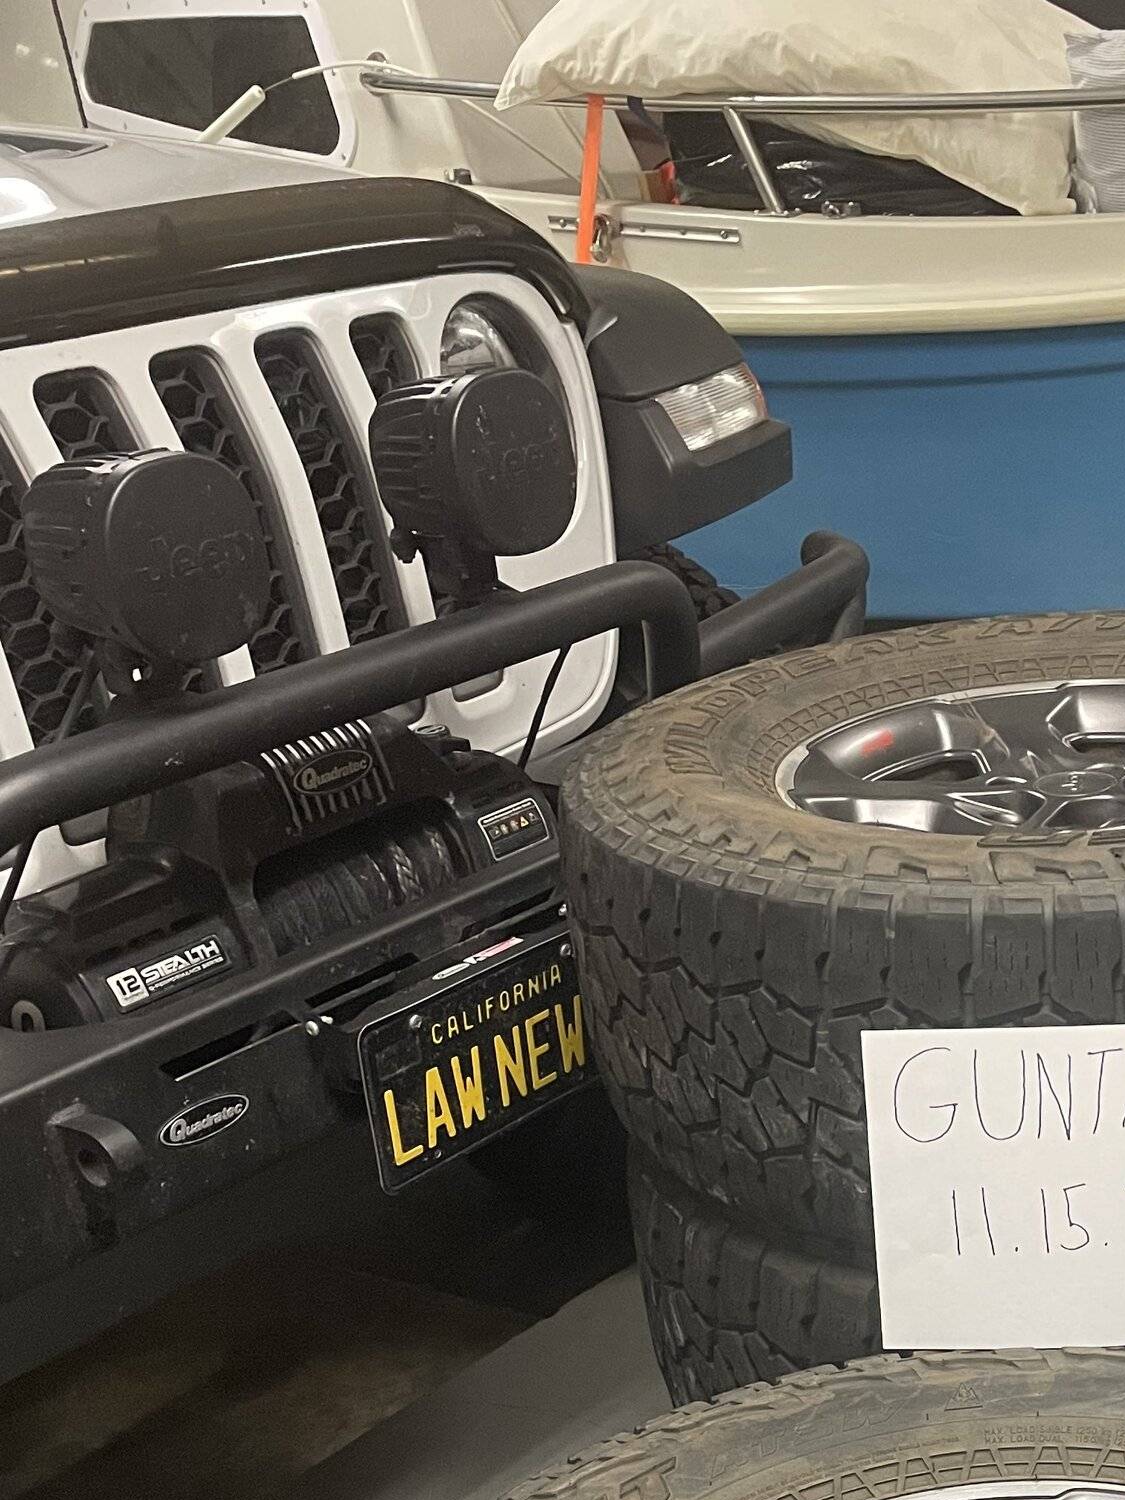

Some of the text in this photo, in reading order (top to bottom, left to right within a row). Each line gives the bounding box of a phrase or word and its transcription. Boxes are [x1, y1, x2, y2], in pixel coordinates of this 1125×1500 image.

[134, 529, 258, 582] Jeep
[302, 760, 367, 790] Quadratec
[116, 940, 220, 996] 12 STEALTH
[431, 964, 562, 1045] CALIFORNIA
[170, 1103, 243, 1142] Quadratec
[383, 1045, 487, 1166] LAW
